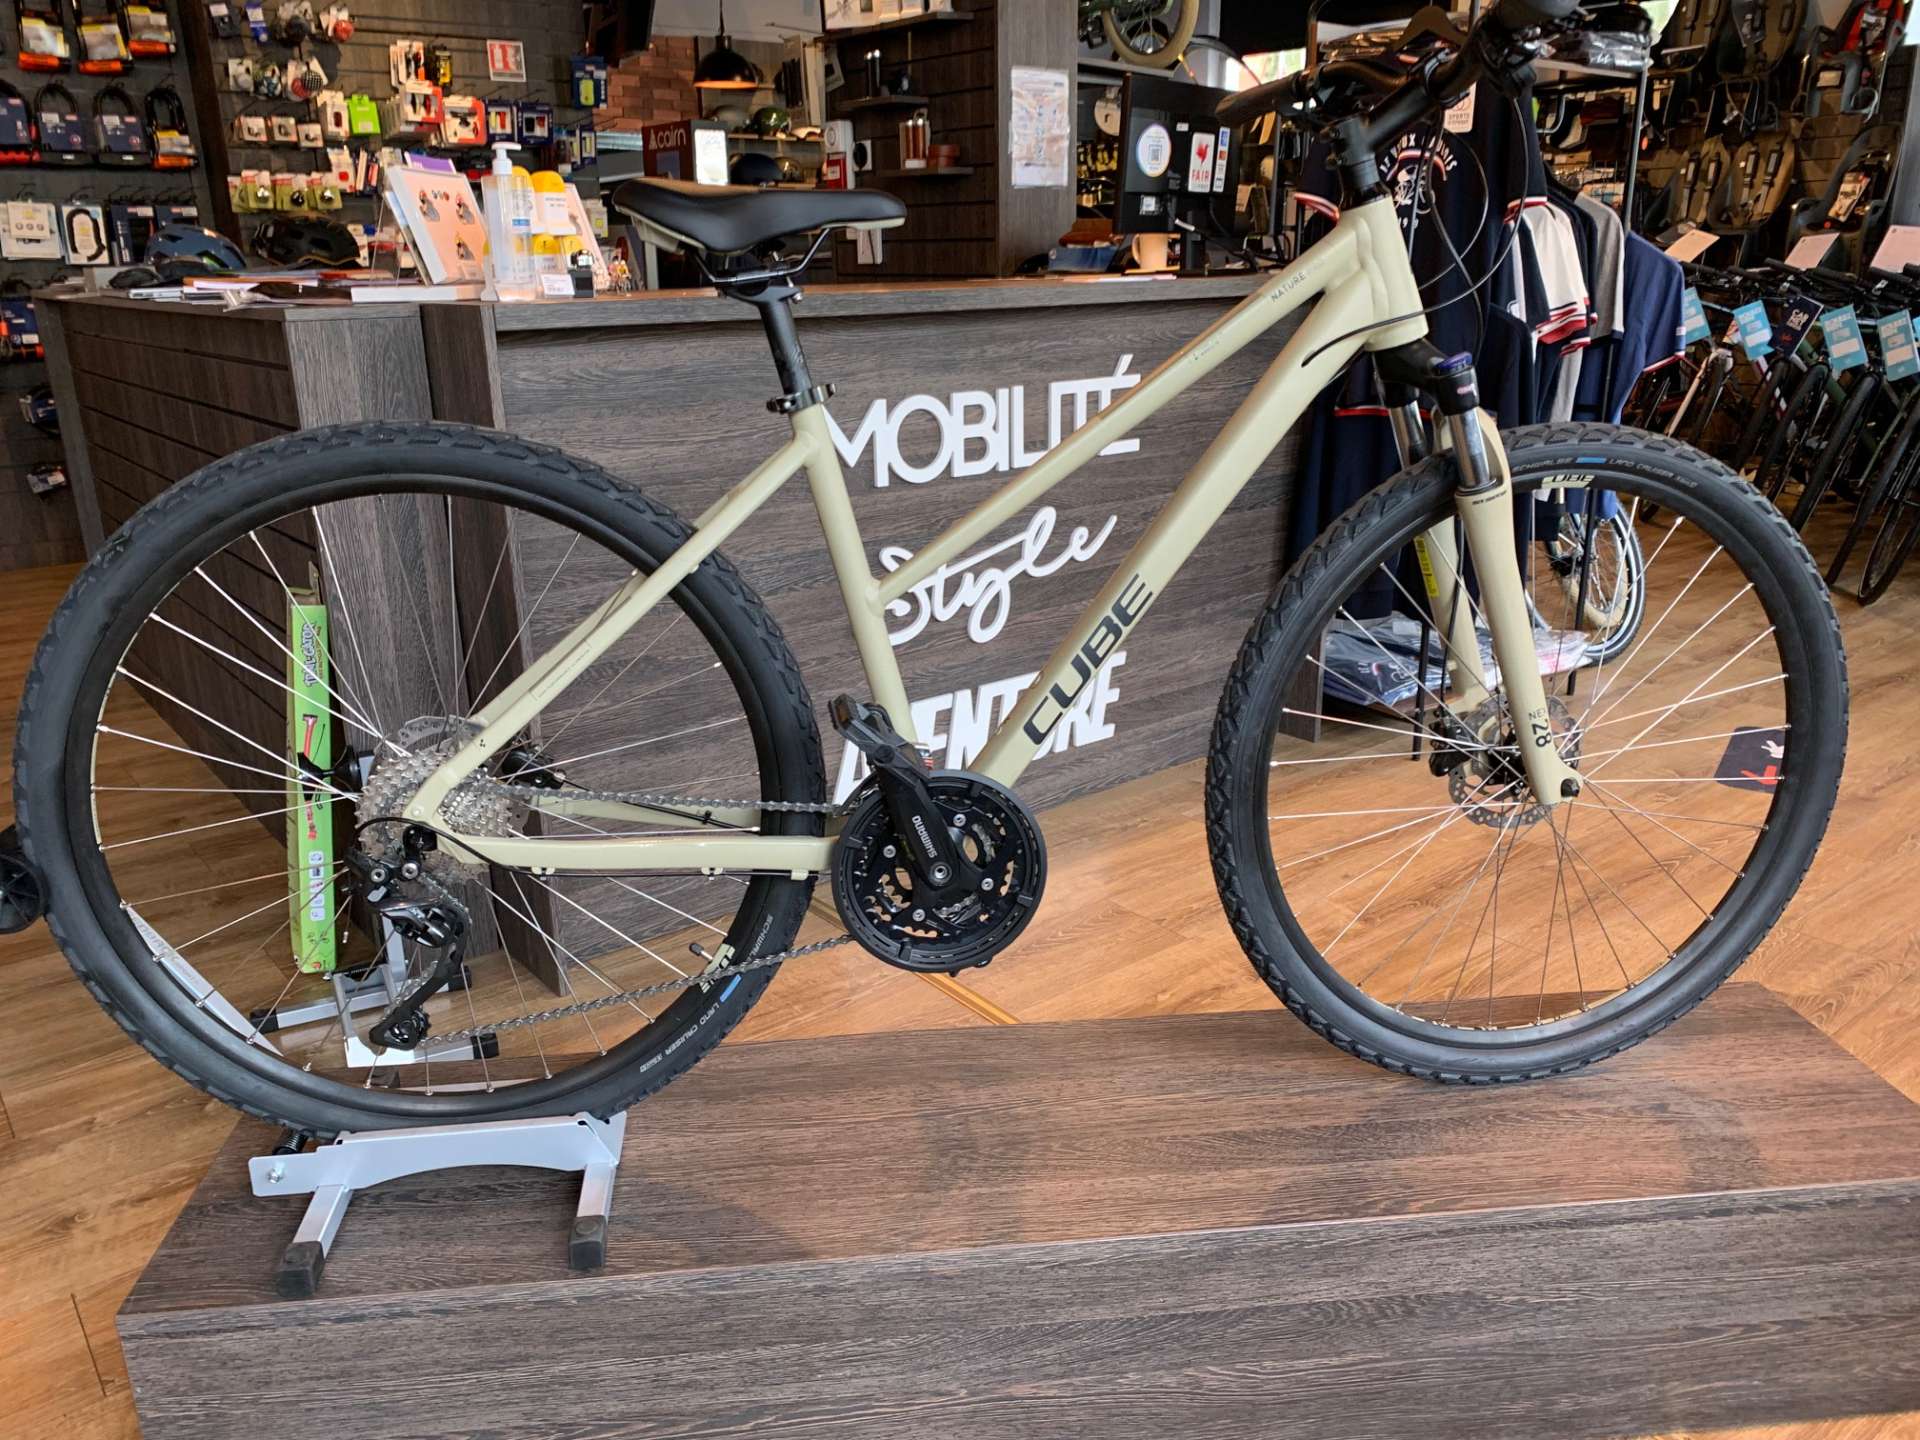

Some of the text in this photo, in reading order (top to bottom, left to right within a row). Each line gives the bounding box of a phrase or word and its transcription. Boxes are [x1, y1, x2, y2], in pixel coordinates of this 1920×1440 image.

[657, 126, 686, 148] cairn
[1191, 169, 1210, 184] FAIR
[1271, 271, 1307, 304] NATURE
[822, 353, 1141, 488] MOBILITÉ
[878, 505, 1118, 645] Style
[1022, 574, 1154, 746] CUBE
[1531, 719, 1551, 747] 28
[911, 814, 939, 859] SHIMANO
[699, 1002, 719, 1025] LAND
[665, 1025, 698, 1056] CRUISER
